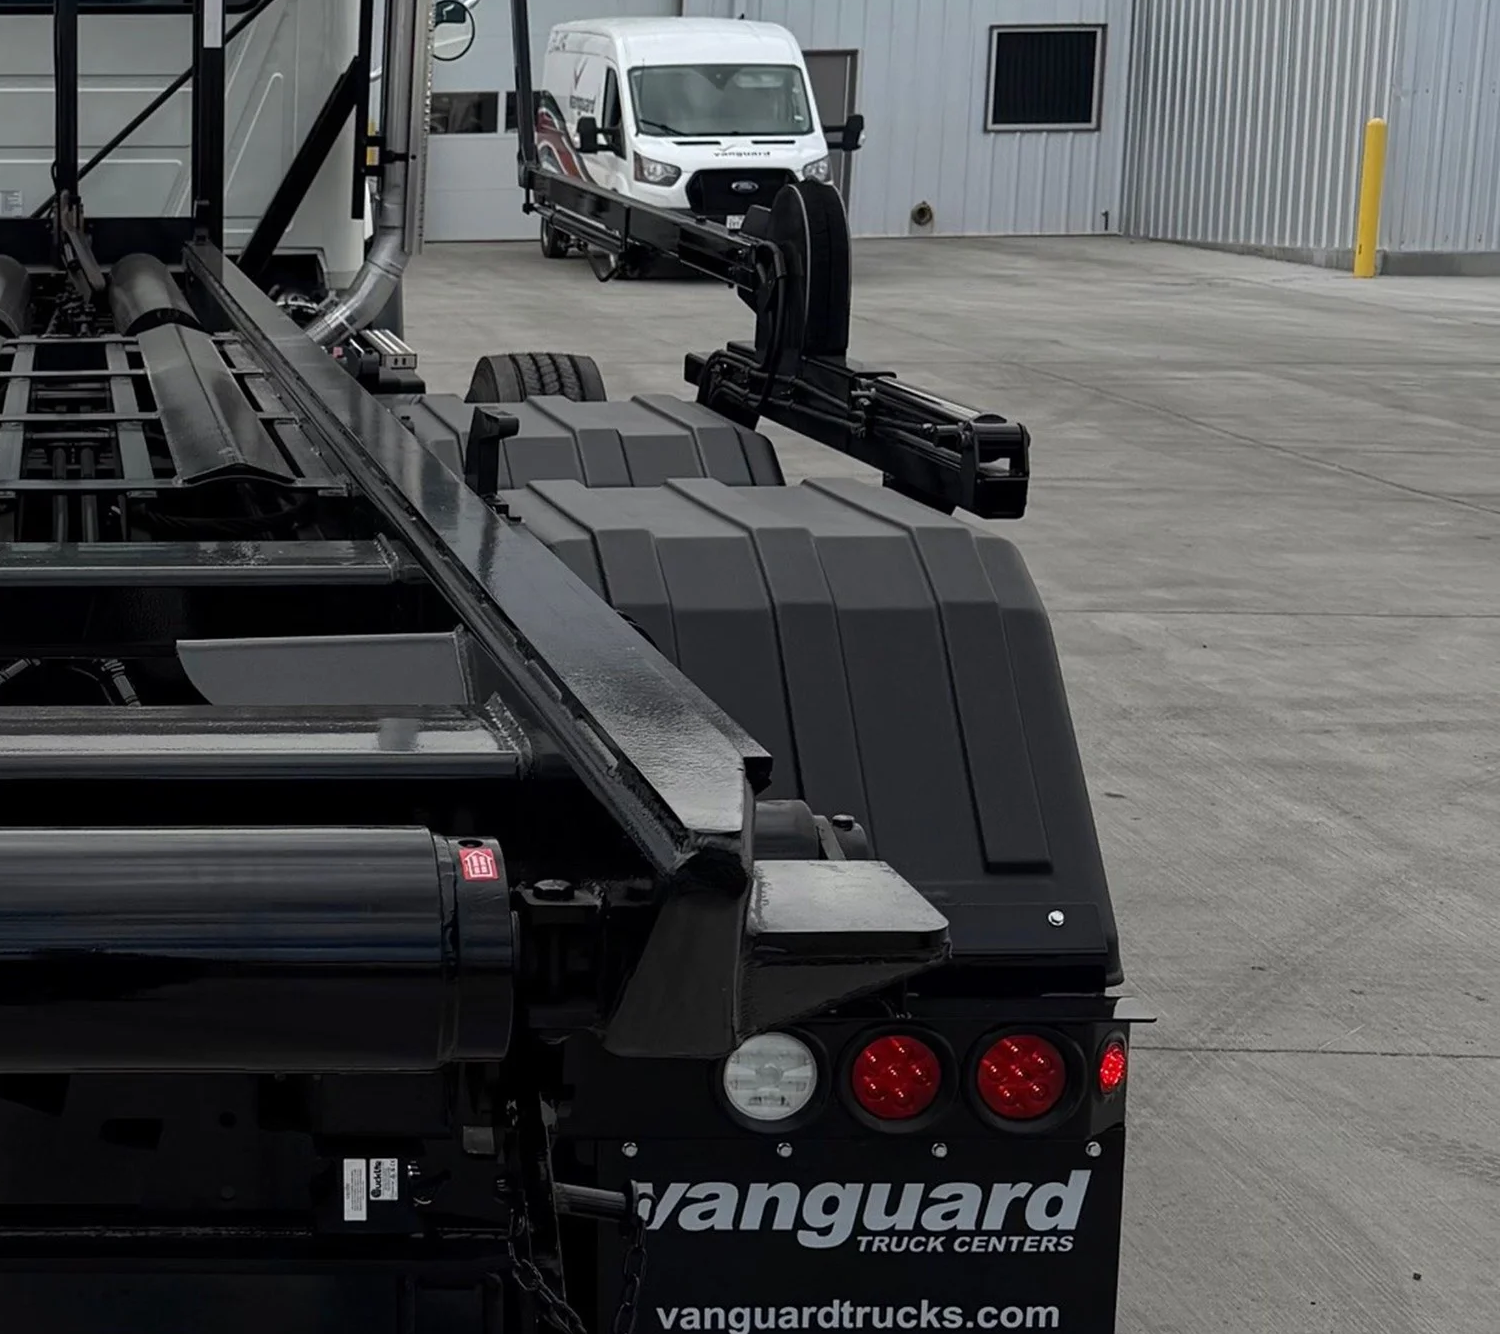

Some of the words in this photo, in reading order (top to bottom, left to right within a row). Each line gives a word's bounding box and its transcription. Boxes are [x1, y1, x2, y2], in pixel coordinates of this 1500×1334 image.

[629, 1169, 1092, 1249] vanguard
[856, 1236, 947, 1253] TRUCK
[953, 1235, 1074, 1253] CENTERS
